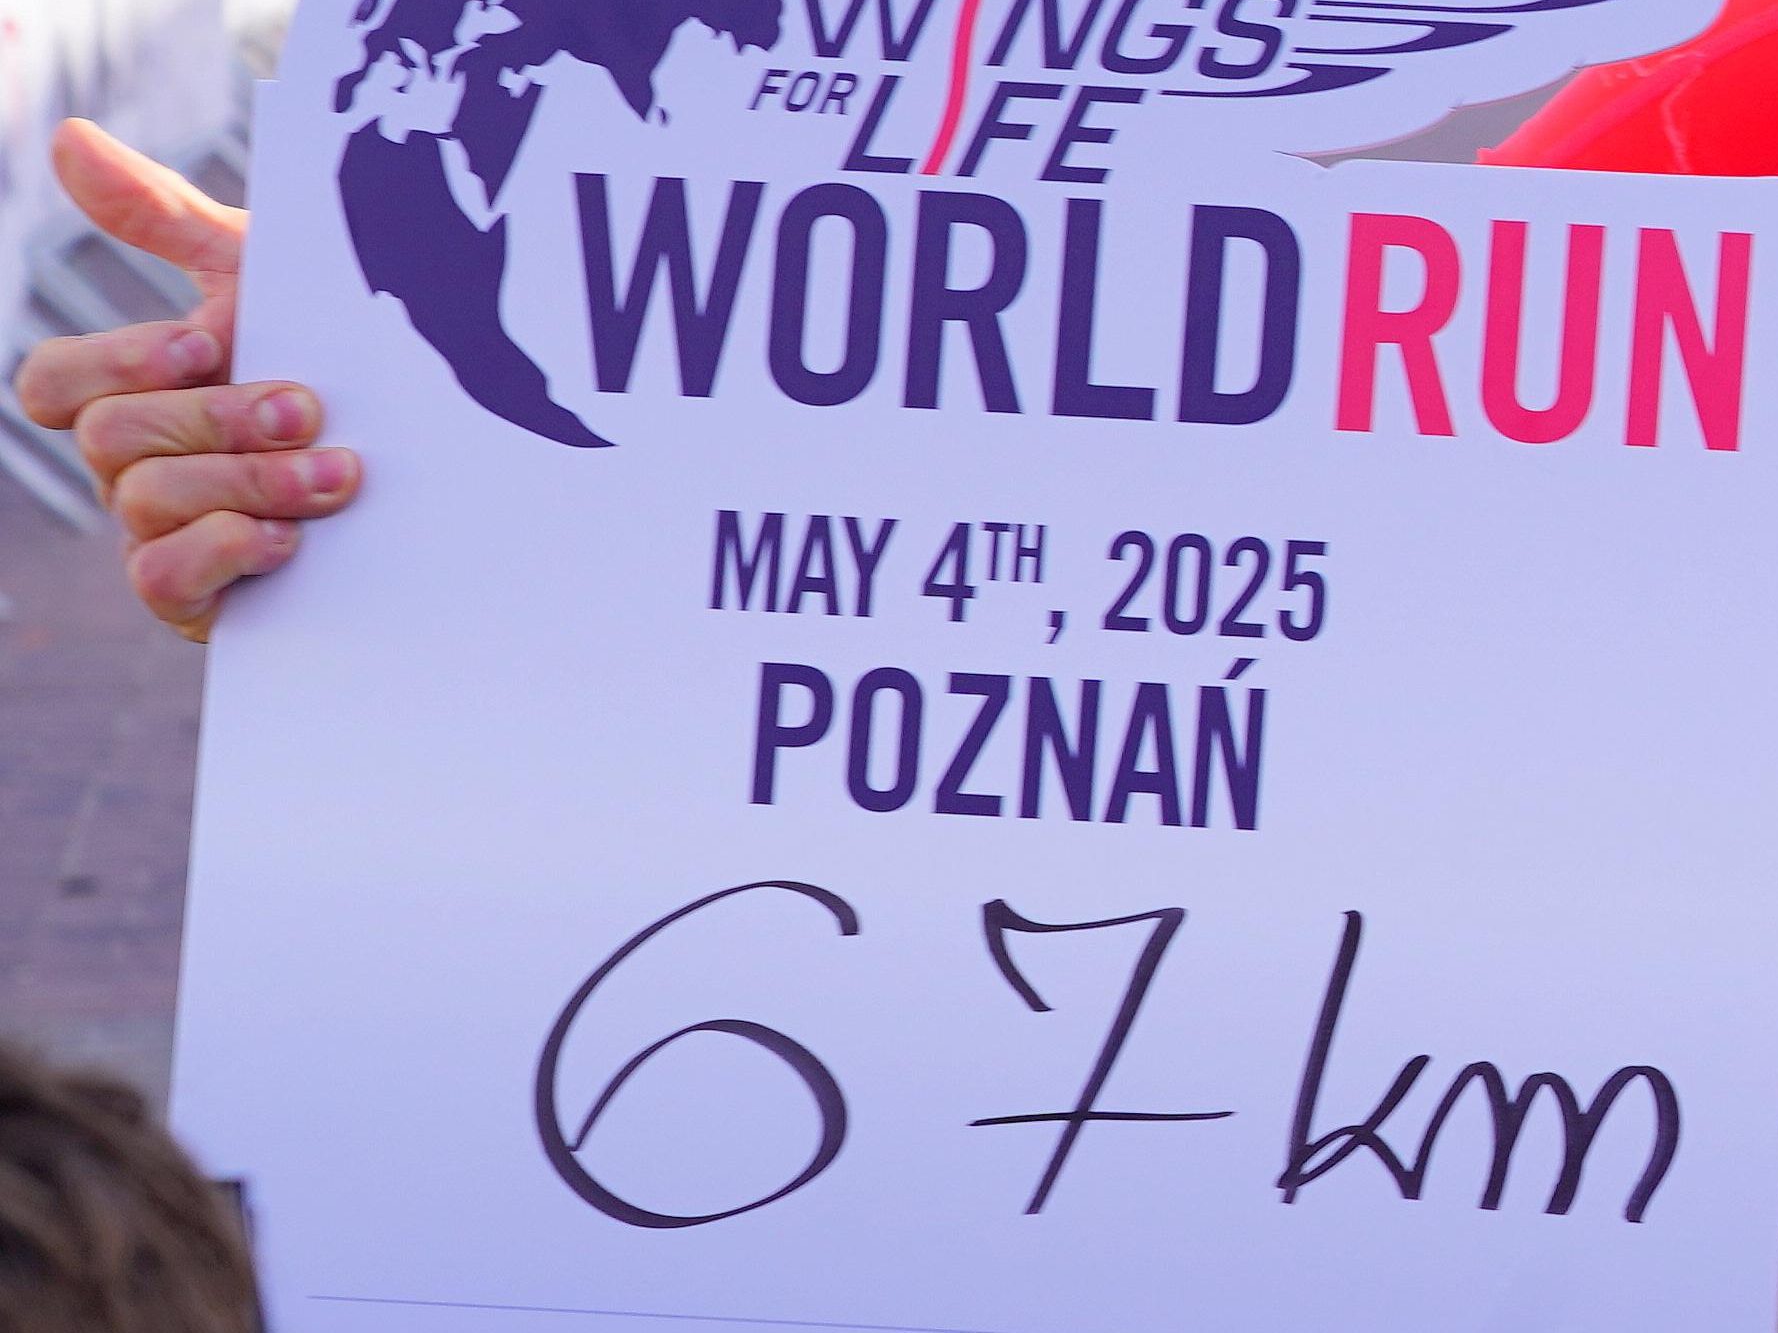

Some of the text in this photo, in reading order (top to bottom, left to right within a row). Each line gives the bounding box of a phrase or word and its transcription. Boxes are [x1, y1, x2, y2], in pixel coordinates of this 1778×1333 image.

[747, 70, 858, 115] FOR
[575, 174, 1754, 452] WORLD RUN
[708, 509, 900, 617] MAY
[1101, 530, 1329, 642] 2025
[750, 658, 1269, 831] POZNAŃ
[1275, 909, 1685, 1226] km
